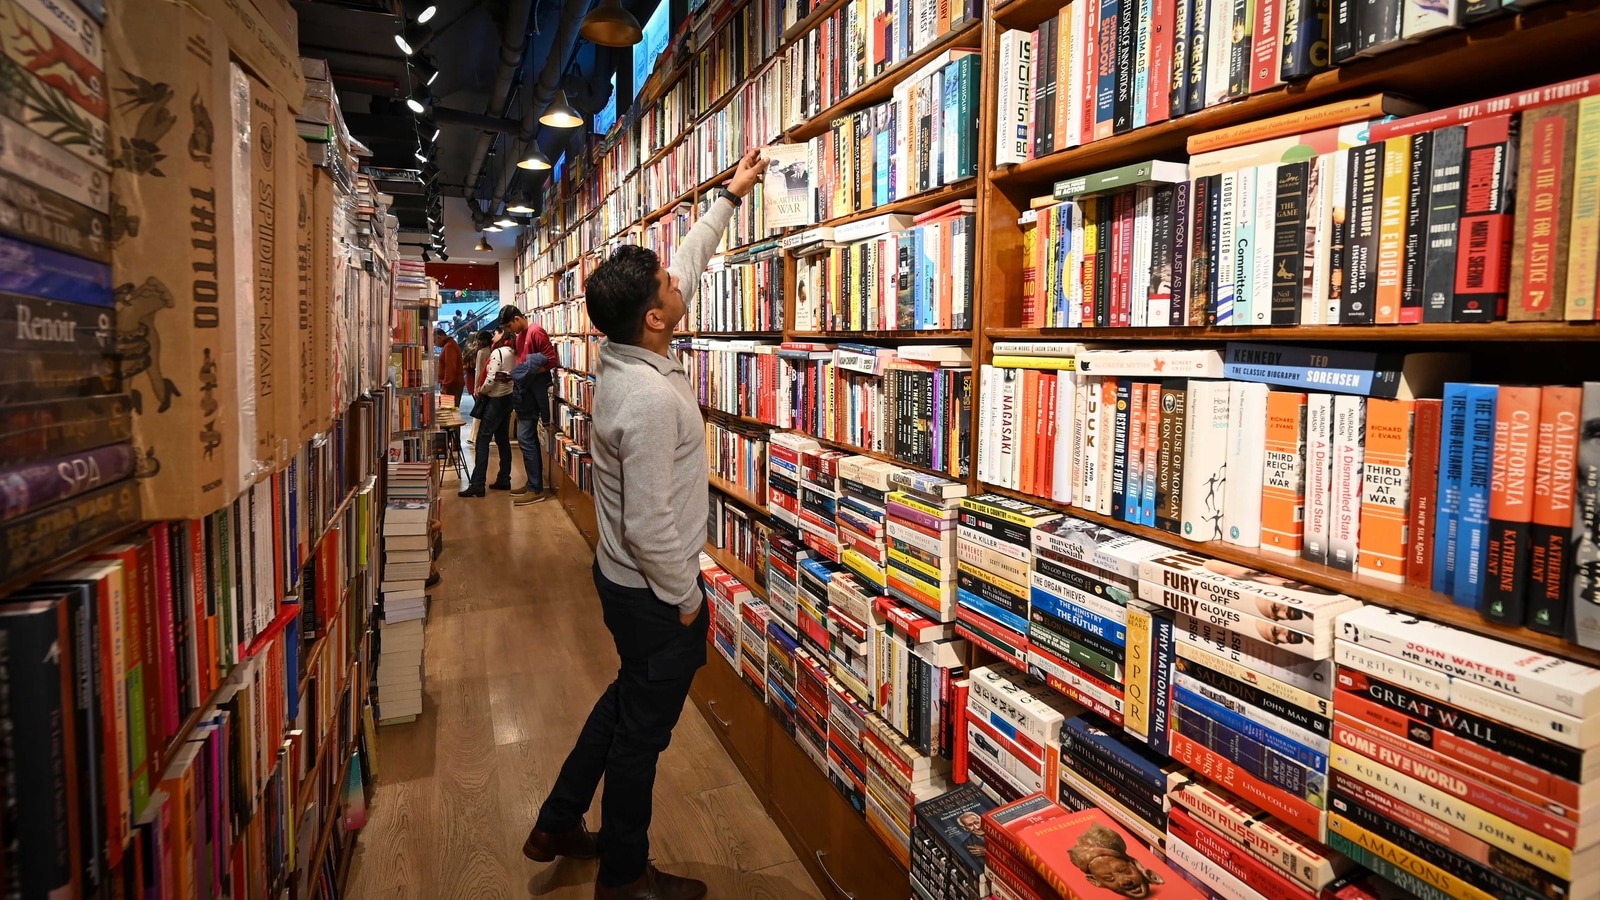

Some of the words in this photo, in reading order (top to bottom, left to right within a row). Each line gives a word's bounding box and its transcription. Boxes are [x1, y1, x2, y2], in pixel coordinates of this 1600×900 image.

[1100, 17, 1110, 76] SHADOW
[1109, 14, 1117, 74] CHURCHILL'S
[1138, 27, 1147, 74] NOMADS
[1191, 34, 1205, 84] CREWS
[1119, 47, 1129, 102] INNOVATIONS
[1152, 59, 1161, 91] Mosquito
[1172, 41, 1185, 90] CREWS
[1518, 90, 1541, 107] WAR
[1544, 80, 1590, 102] STORIES
[1363, 147, 1377, 192] CRUSADE
[1537, 166, 1555, 189] THE
[1177, 185, 1186, 216] CICELY
[1280, 202, 1295, 210] THE
[1383, 195, 1401, 227] MAN
[1410, 186, 1421, 207] Than
[1535, 192, 1553, 212] CRY
[1276, 209, 1299, 218] GAME
[1360, 206, 1373, 237] EUROPE
[1532, 217, 1551, 238] FOR
[1176, 216, 1185, 248] TYSON
[1221, 212, 1232, 255] REVISITED
[1471, 221, 1488, 247] MARTIN
[190, 186, 219, 329] TATTOO
[1152, 242, 1160, 277] HISTORY
[1174, 252, 1182, 274] JUST
[1236, 238, 1248, 303] Committed
[1350, 244, 1360, 294] EISENHOWER
[1359, 247, 1368, 279] DWIGHT
[1379, 233, 1399, 287] ENOUGH
[1466, 256, 1485, 288] SHERWIN
[1530, 241, 1549, 284] JUSTICE
[257, 179, 274, 397] SPIDER-MAN
[1084, 260, 1093, 303] MONSOON
[16, 304, 77, 342] Renoir
[1233, 348, 1283, 366] KENNEDY
[1310, 354, 1329, 368] TED
[1232, 366, 1242, 375] THE
[1243, 367, 1266, 378] CLASSIC
[1267, 370, 1301, 381] BIOGRAPHY
[1306, 369, 1361, 388] SORENSEN
[1048, 380, 1056, 410] Marriage
[1176, 392, 1185, 414] THE
[1001, 395, 1013, 455] NAGASAKI
[1115, 412, 1126, 453] RESTARTING
[1162, 418, 1171, 439] RON
[1174, 417, 1183, 453] HOUSE
[1370, 425, 1402, 433] RICHARD
[1473, 418, 1491, 442] LONG
[1161, 440, 1170, 491] CHERNOW
[1266, 461, 1294, 471] REICH
[1267, 452, 1293, 462] THIRD
[1469, 444, 1489, 489] ALLIANCE
[1491, 421, 1509, 492] BURNING
[1506, 410, 1530, 506] CALIFORNIA
[1535, 422, 1554, 496] BURNING
[1552, 410, 1575, 511] CALIFORNIA
[57, 456, 101, 499] SPA
[1112, 468, 1124, 495] FUTURE
[1269, 478, 1290, 488] WAR
[1315, 451, 1325, 506] Dismantled
[1171, 471, 1181, 520] MORGAN
[1314, 508, 1323, 533] State
[979, 536, 997, 547] KILLER
[1049, 537, 1085, 555] maverick
[1051, 544, 1083, 560] messiah
[1415, 542, 1425, 565] ROADS
[1092, 558, 1120, 572] KANDULA
[1093, 552, 1117, 565] RAMESH
[1488, 540, 1499, 576] BLUNT
[1500, 529, 1517, 592] KATHERINE
[1043, 577, 1062, 593] ORGAN
[1063, 587, 1086, 604] THIEVES
[1163, 570, 1200, 596] FURY
[1200, 581, 1240, 601] GLOVES
[1209, 593, 1230, 606] OFF
[1056, 608, 1072, 622] THE
[1072, 616, 1104, 637] FUTURE
[1071, 604, 1103, 624] MINISTRY
[1128, 613, 1148, 625] MARY
[1163, 591, 1199, 617] FURY
[1200, 602, 1240, 623] GLOVES
[1209, 615, 1230, 628] OFF
[1159, 623, 1169, 651] WHY
[1189, 617, 1198, 642] RISE
[1216, 630, 1226, 653] KILL
[1230, 631, 1241, 662] FIRST
[1345, 651, 1394, 676] fragile
[1402, 668, 1441, 691] lives
[1402, 650, 1421, 662] MR
[1424, 658, 1521, 694] KNOW-IT-ALL
[1406, 642, 1446, 660] JOHN
[1451, 655, 1518, 683] WATERS
[1156, 651, 1168, 707] NATIONS
[1195, 667, 1256, 702] SALADIN
[1263, 697, 1285, 714] JOHN
[1287, 709, 1308, 724] MAN
[1154, 708, 1166, 733] FAIL
[1369, 684, 1437, 718] GREAT
[1438, 710, 1498, 744] WALL
[1074, 743, 1096, 761] ATTILA
[1107, 762, 1125, 781] HUN
[1182, 742, 1192, 764] Gun
[1203, 753, 1215, 776] Ship
[1339, 729, 1377, 757] COME
[1379, 745, 1401, 765] FLY
[1412, 761, 1467, 797] WORLD
[1075, 760, 1094, 780] ELON
[1095, 774, 1117, 795] MUSK
[1224, 766, 1235, 787] Pen
[937, 786, 976, 807] HAPPIEST
[956, 792, 983, 807] EARTH
[1242, 781, 1266, 799] LINDA
[1267, 794, 1300, 817] COLLEY
[1336, 775, 1364, 794] WHERE
[1364, 788, 1392, 807] CHINA
[1424, 817, 1450, 836] INDIA
[1177, 790, 1195, 807] WHO
[1196, 798, 1217, 820] LOST
[1218, 814, 1279, 857] RUSSIA?
[1356, 763, 1408, 795] KUBLAI
[1418, 792, 1467, 823] KHAN
[1478, 821, 1516, 846] JOHN
[1522, 842, 1557, 864] MAN
[1195, 829, 1231, 858] Culture
[1356, 806, 1380, 825] THE
[1385, 820, 1473, 874] TERRACOTTA
[1479, 866, 1530, 899] ARMY
[1169, 843, 1189, 862] Acts
[1200, 863, 1220, 884] War
[1195, 839, 1249, 881] Imperialism
[1358, 832, 1451, 890] AMAZONS
